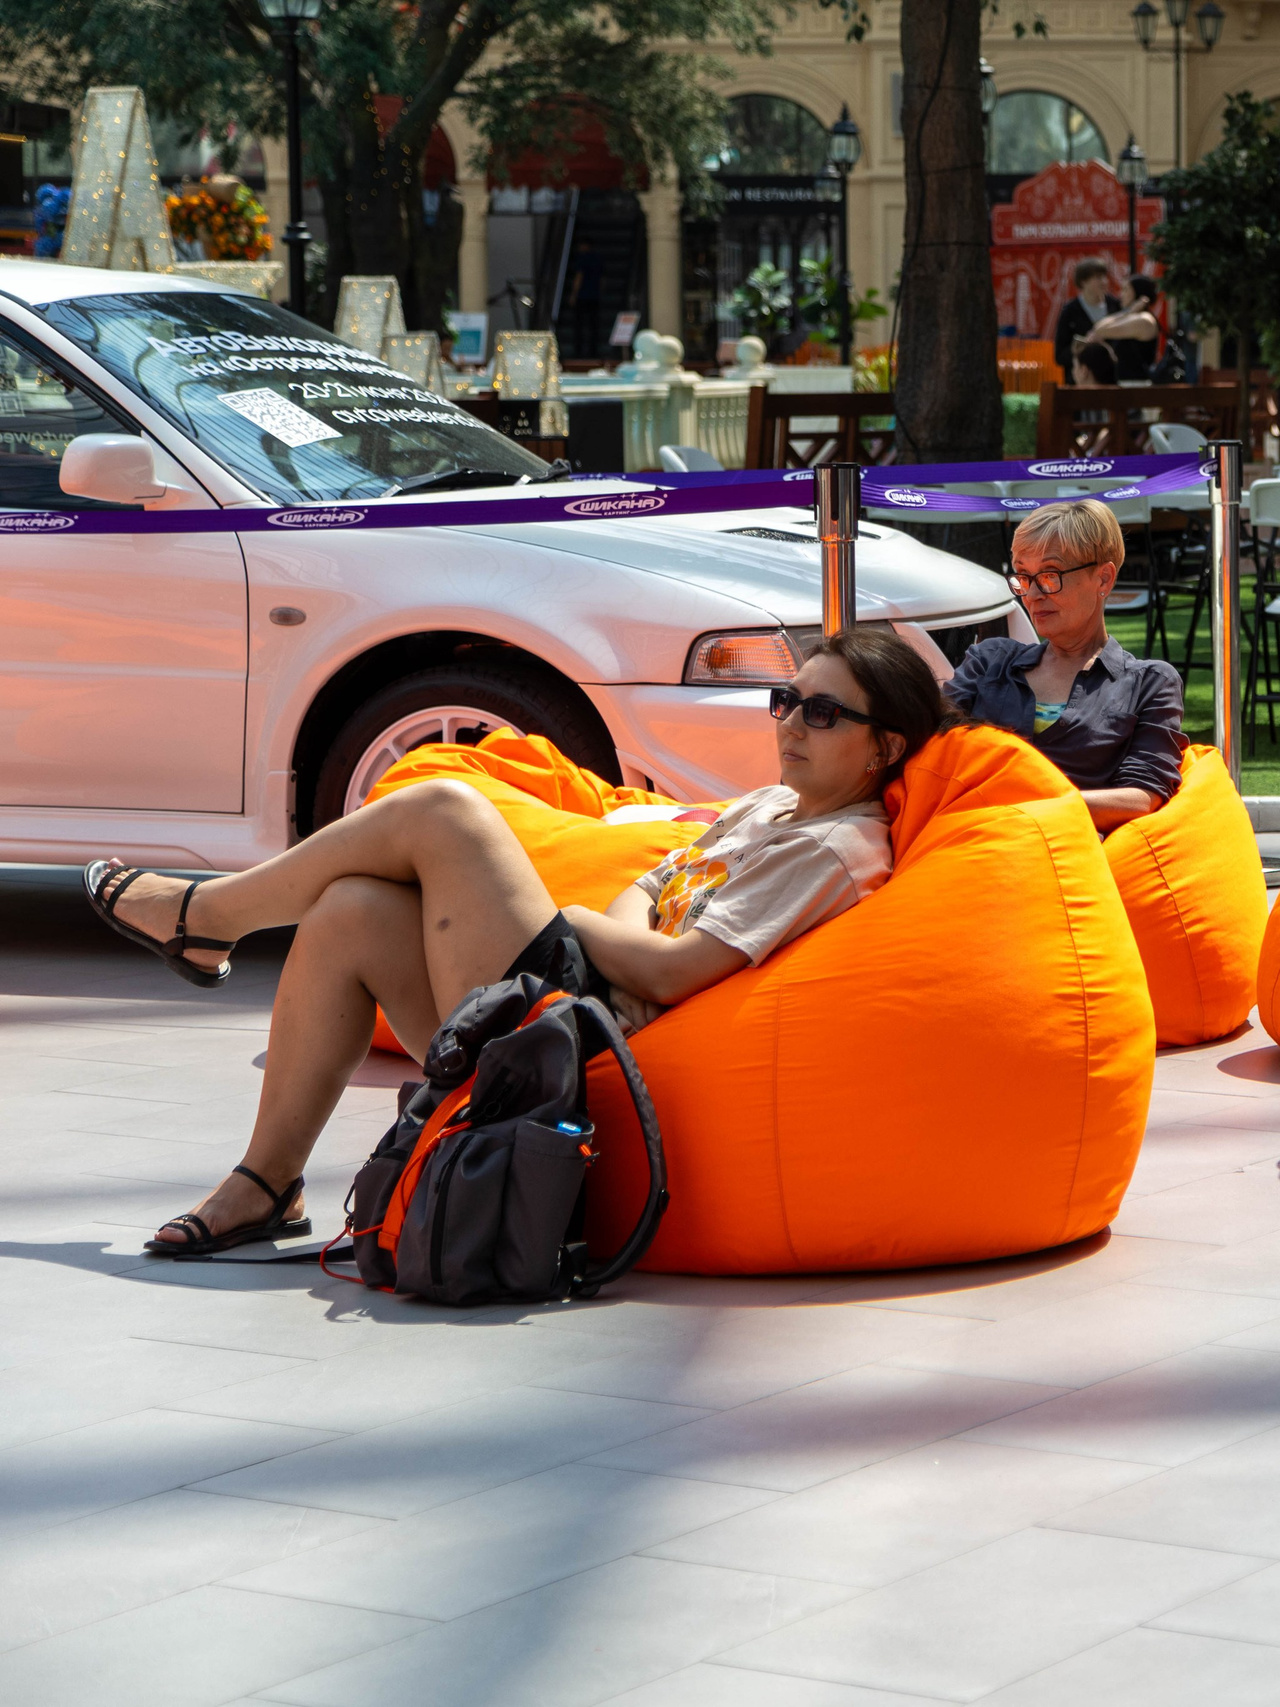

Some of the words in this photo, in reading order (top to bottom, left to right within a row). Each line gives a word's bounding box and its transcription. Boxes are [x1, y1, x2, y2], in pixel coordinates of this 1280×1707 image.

[181, 361, 225, 378] на
[1041, 463, 1104, 473] ШИКАНА
[580, 498, 656, 512] ШИКАНА
[282, 512, 356, 524] ШИКАНА
